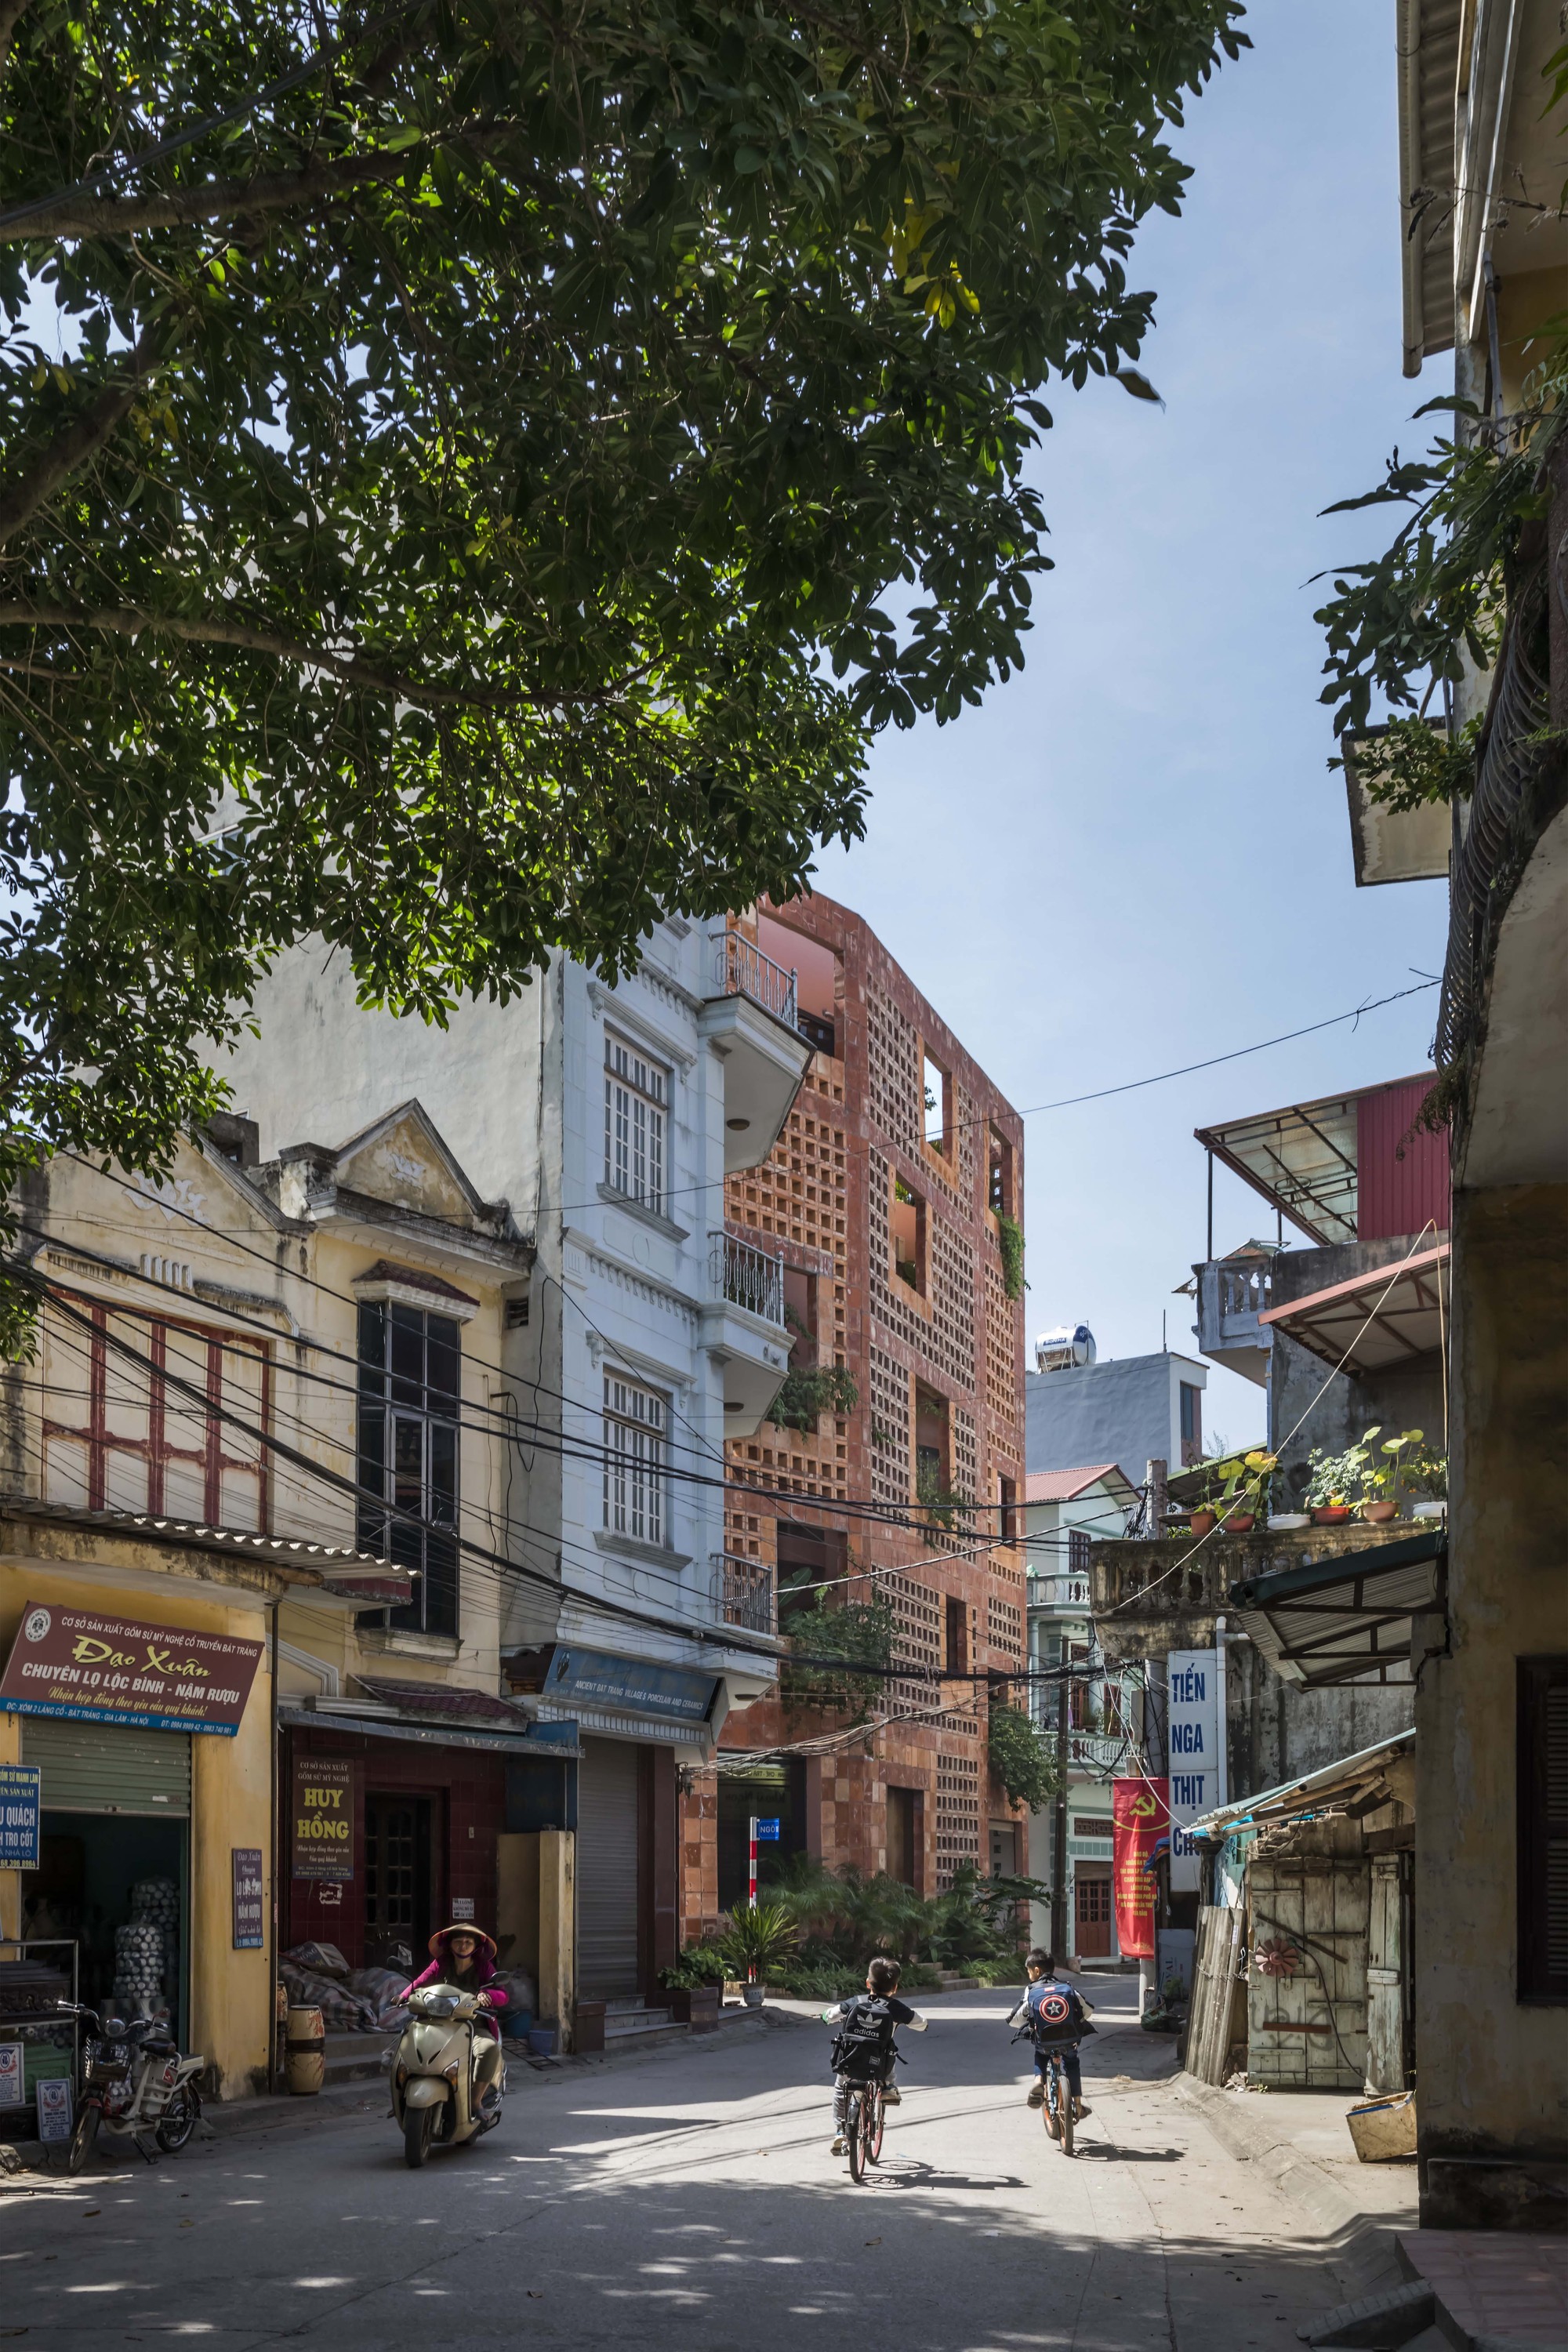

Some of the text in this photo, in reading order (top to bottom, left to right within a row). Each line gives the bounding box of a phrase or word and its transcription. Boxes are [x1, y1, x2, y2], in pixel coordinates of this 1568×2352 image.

[62, 1617, 74, 1626] CƠ
[74, 1616, 86, 1628] SỞ
[87, 1619, 103, 1632] SẢN
[103, 1623, 124, 1635] XUẤT
[125, 1625, 141, 1638] GỐM
[142, 1629, 153, 1640] SỨ
[153, 1632, 164, 1642] MỸ
[165, 1635, 184, 1646] NGHỆ
[185, 1635, 196, 1646] CỔ
[196, 1639, 222, 1651] TRUYỀN
[222, 1643, 235, 1653] BÁT
[237, 1646, 257, 1657] TRÀNG
[71, 1635, 212, 1676] Đạo Xuân
[21, 1662, 81, 1682] CHUYÊN
[82, 1671, 101, 1688] LỌ
[103, 1672, 129, 1690] LỘC
[132, 1676, 165, 1694] BÌNH
[175, 1682, 205, 1700] NẬM
[206, 1688, 240, 1705] RƯỢU
[575, 1680, 597, 1691] ANCIENT
[597, 1683, 607, 1693] BAT
[608, 1686, 623, 1696] TRANG
[648, 1693, 671, 1705] PORCELAIN
[671, 1697, 682, 1706] AND
[682, 1699, 704, 1711] CERAMICS
[1171, 1663, 1205, 1703] TIẾN
[6, 1702, 16, 1711] ĐC:
[18, 1704, 33, 1712] XÓM
[49, 1686, 74, 1702] Nhận
[75, 1690, 92, 1705] hợp
[93, 1691, 114, 1708] đồng
[115, 1695, 132, 1708] theo
[1171, 1723, 1203, 1753] NGA
[298, 1771, 312, 1780] GỐM
[332, 1762, 348, 1772] XUẤT
[304, 1788, 343, 1808] HUY
[1172, 1775, 1205, 1810] THỊT
[6, 1803, 35, 1828] QUÁCH
[297, 1810, 350, 1839] HỒNG
[5, 1831, 18, 1846] TRO
[20, 1828, 34, 1847] CỐT
[854, 2028, 880, 2038] adidas
